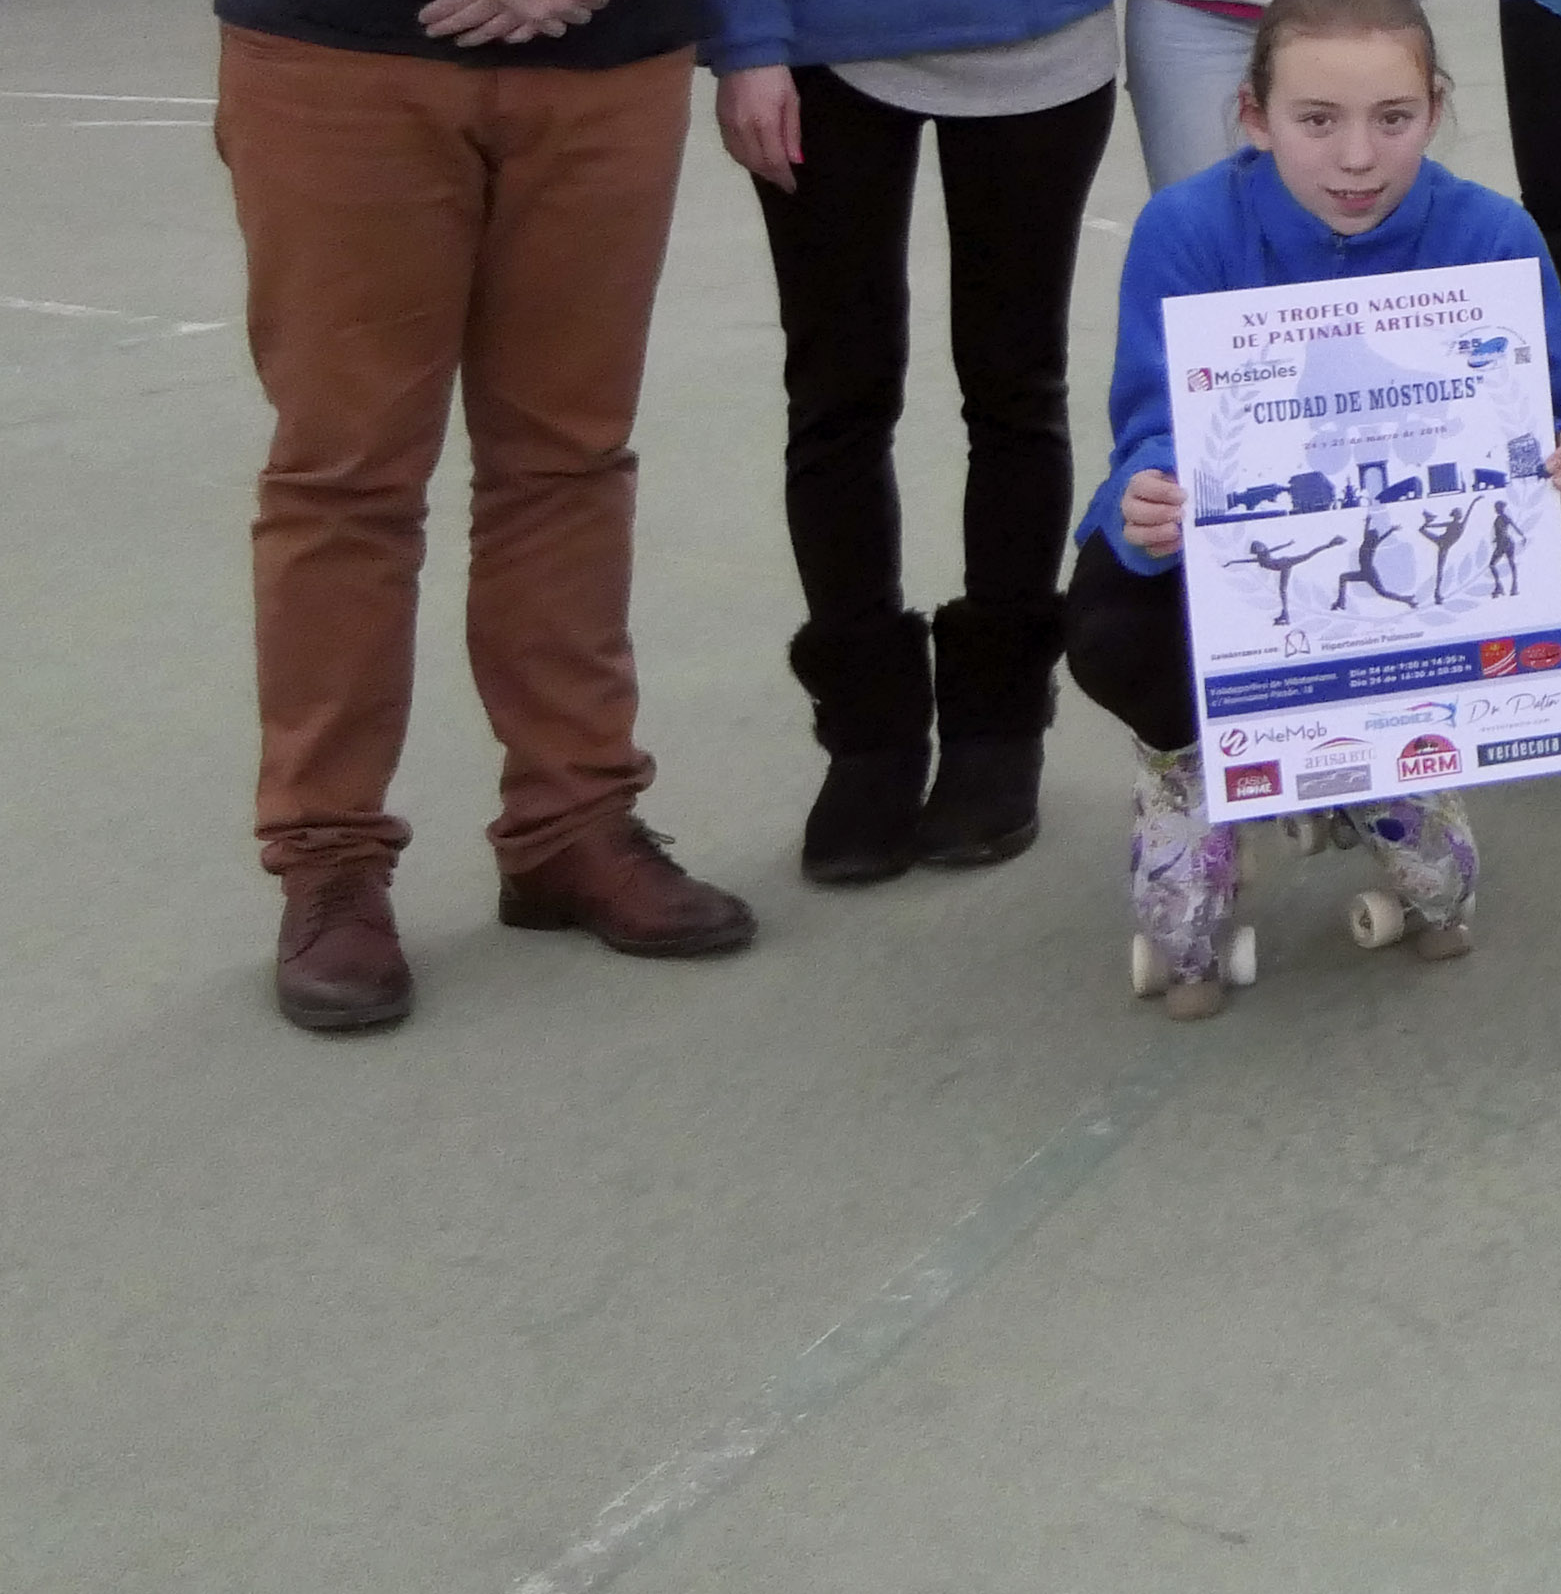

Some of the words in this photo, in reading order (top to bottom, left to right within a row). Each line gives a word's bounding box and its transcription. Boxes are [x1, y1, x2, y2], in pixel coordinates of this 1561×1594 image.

[1242, 312, 1268, 328] XV
[1278, 301, 1359, 324] TROFEO
[1369, 289, 1470, 312] NACIONAL
[1232, 332, 1260, 349] DE
[1269, 320, 1366, 345] PATINAJE
[1375, 307, 1484, 333] ARTÍSTICO
[1214, 364, 1298, 386] Móstoles
[1335, 390, 1363, 415] DE
[1255, 721, 1328, 745] WeMob
[1487, 737, 1560, 761] verdecora
[1401, 754, 1458, 778] MRM
